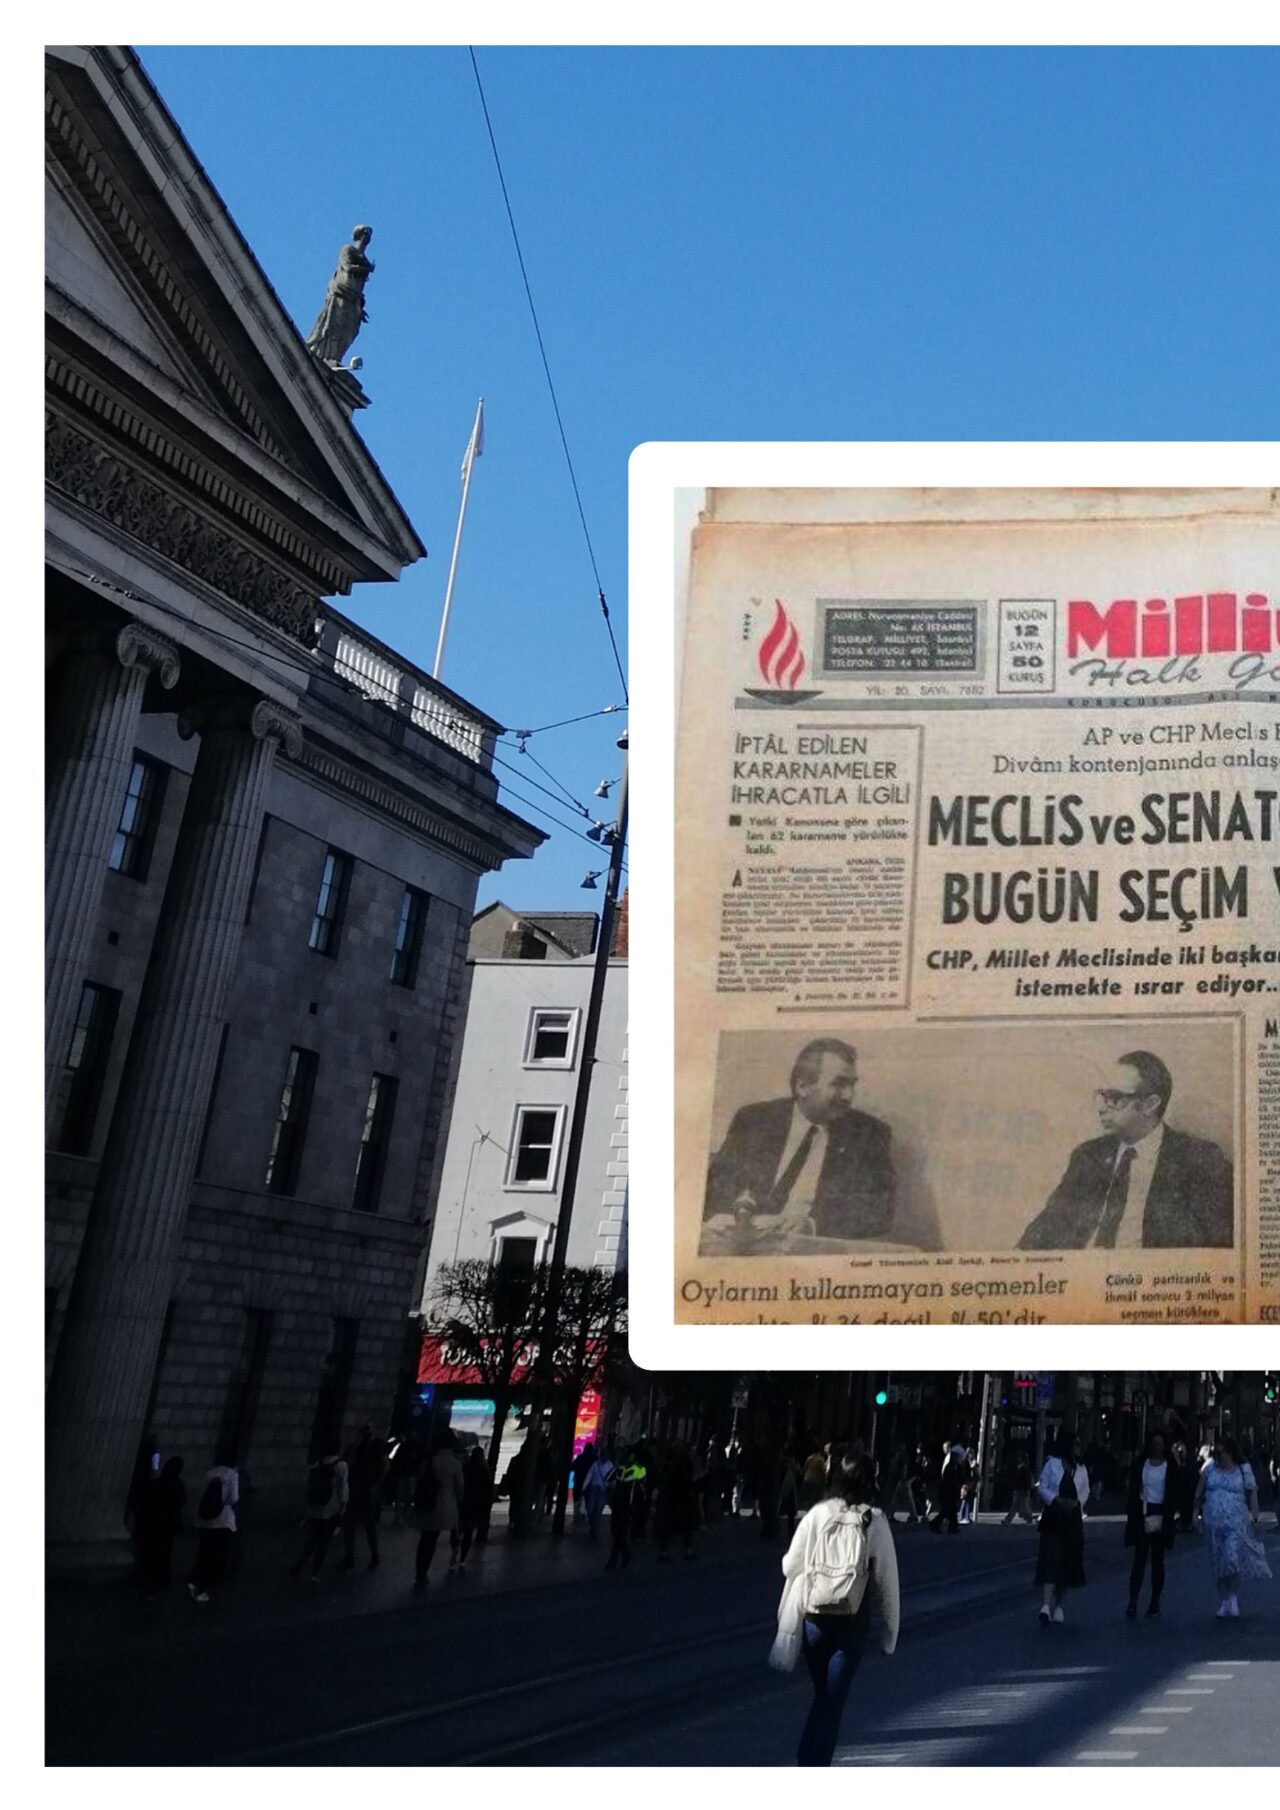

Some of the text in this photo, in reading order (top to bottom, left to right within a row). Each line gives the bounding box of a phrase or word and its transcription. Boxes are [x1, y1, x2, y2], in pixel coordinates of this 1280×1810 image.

[1014, 624, 1040, 637] 12
[1009, 641, 1044, 651] SAYFA
[1012, 655, 1044, 668] 50
[1069, 655, 1203, 688] Halk
[735, 732, 868, 755] İPTÂL EDİLEN
[1083, 727, 1113, 745] AP
[1119, 731, 1144, 745] ve
[1149, 725, 1197, 744] CHP
[733, 761, 897, 780] KARARNAMELER
[993, 754, 1062, 775] Divânı
[1069, 752, 1217, 776] kontenjanında
[731, 783, 911, 805] İHRACATLA İLGİLİ
[1090, 815, 1136, 846] ve
[942, 866, 1100, 925] BUGÜN
[1118, 865, 1249, 933] SEÇİM
[926, 949, 979, 972] CHP,
[985, 948, 1051, 970] Millet
[1055, 946, 1174, 969] Meclisinde
[1179, 944, 1206, 966] iki
[1014, 976, 1123, 998] istemekte
[1133, 979, 1185, 997] ısrar
[680, 1272, 1069, 1308] Oylarını kullanmayan seçmenler
[1105, 1273, 1143, 1287] Çünkü
